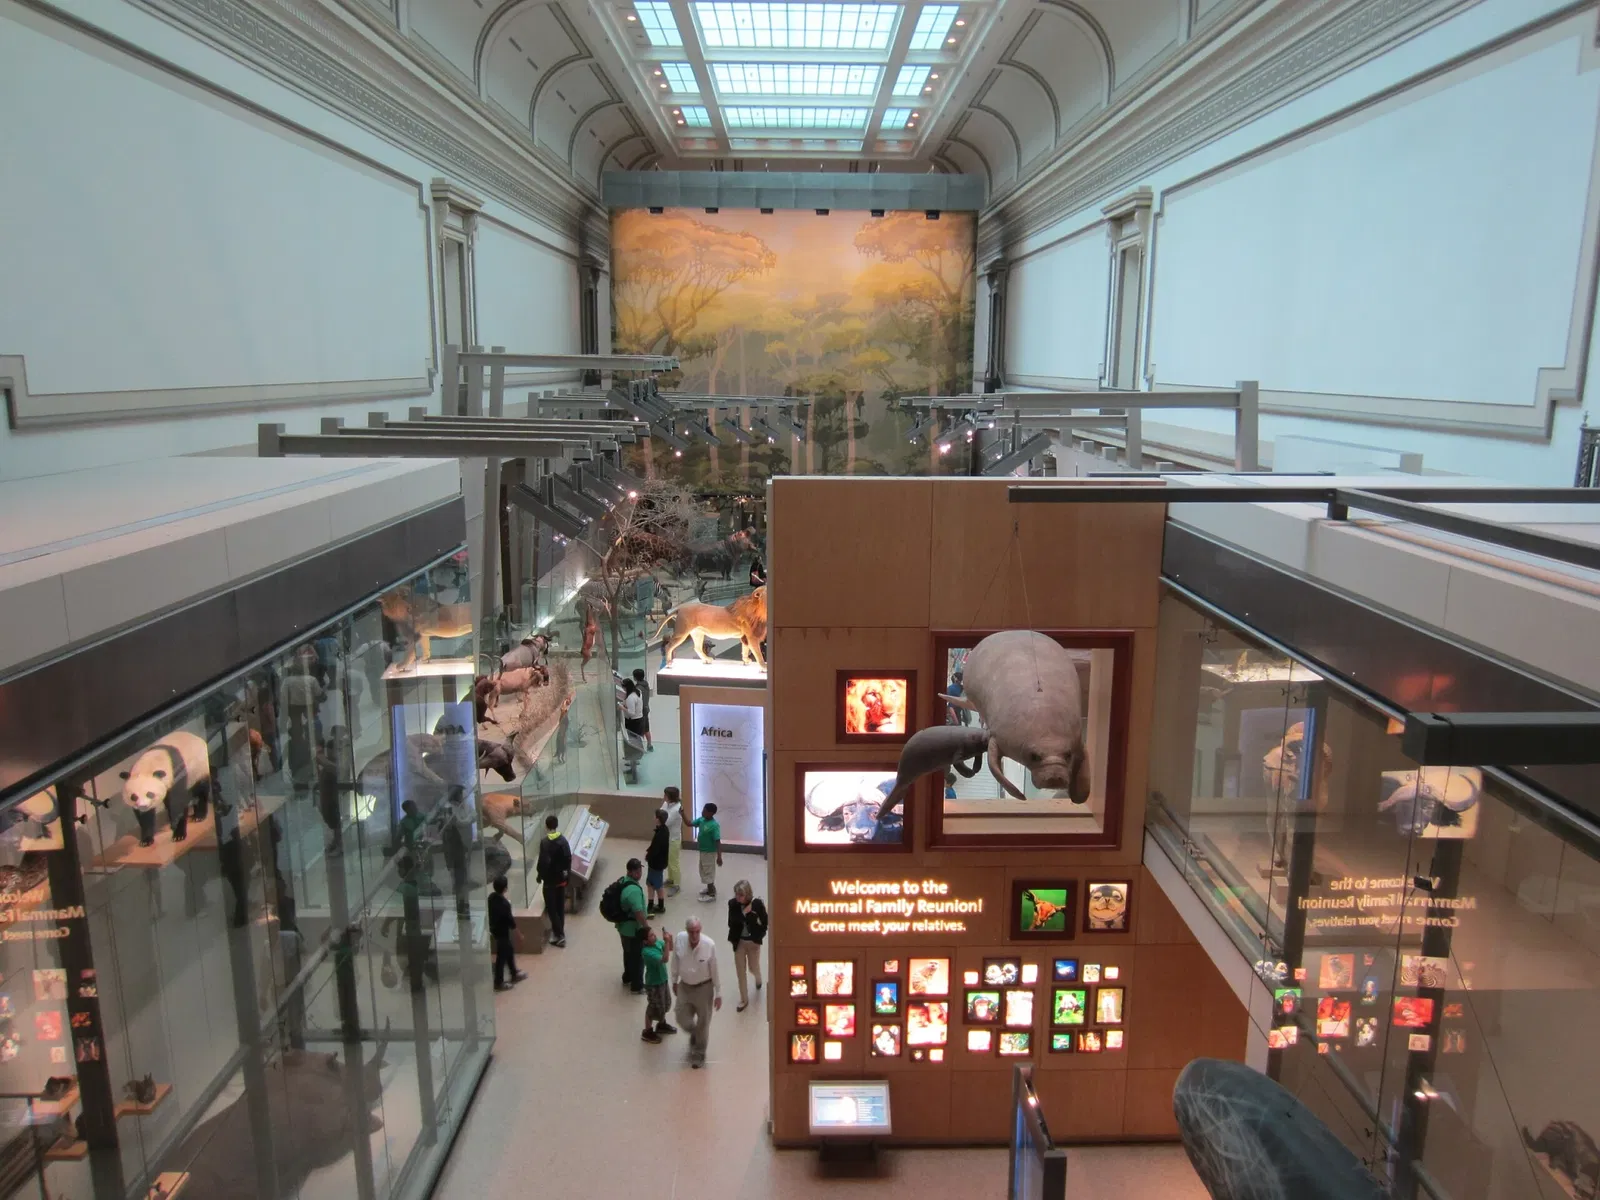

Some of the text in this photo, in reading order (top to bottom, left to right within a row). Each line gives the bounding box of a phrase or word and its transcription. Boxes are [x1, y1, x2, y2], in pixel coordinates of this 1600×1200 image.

[700, 726, 733, 738] Africa
[830, 879, 948, 895] Welcome to the
[795, 898, 983, 917] Mammal Family Reunion!
[809, 919, 967, 935] Come meet your relatives.
